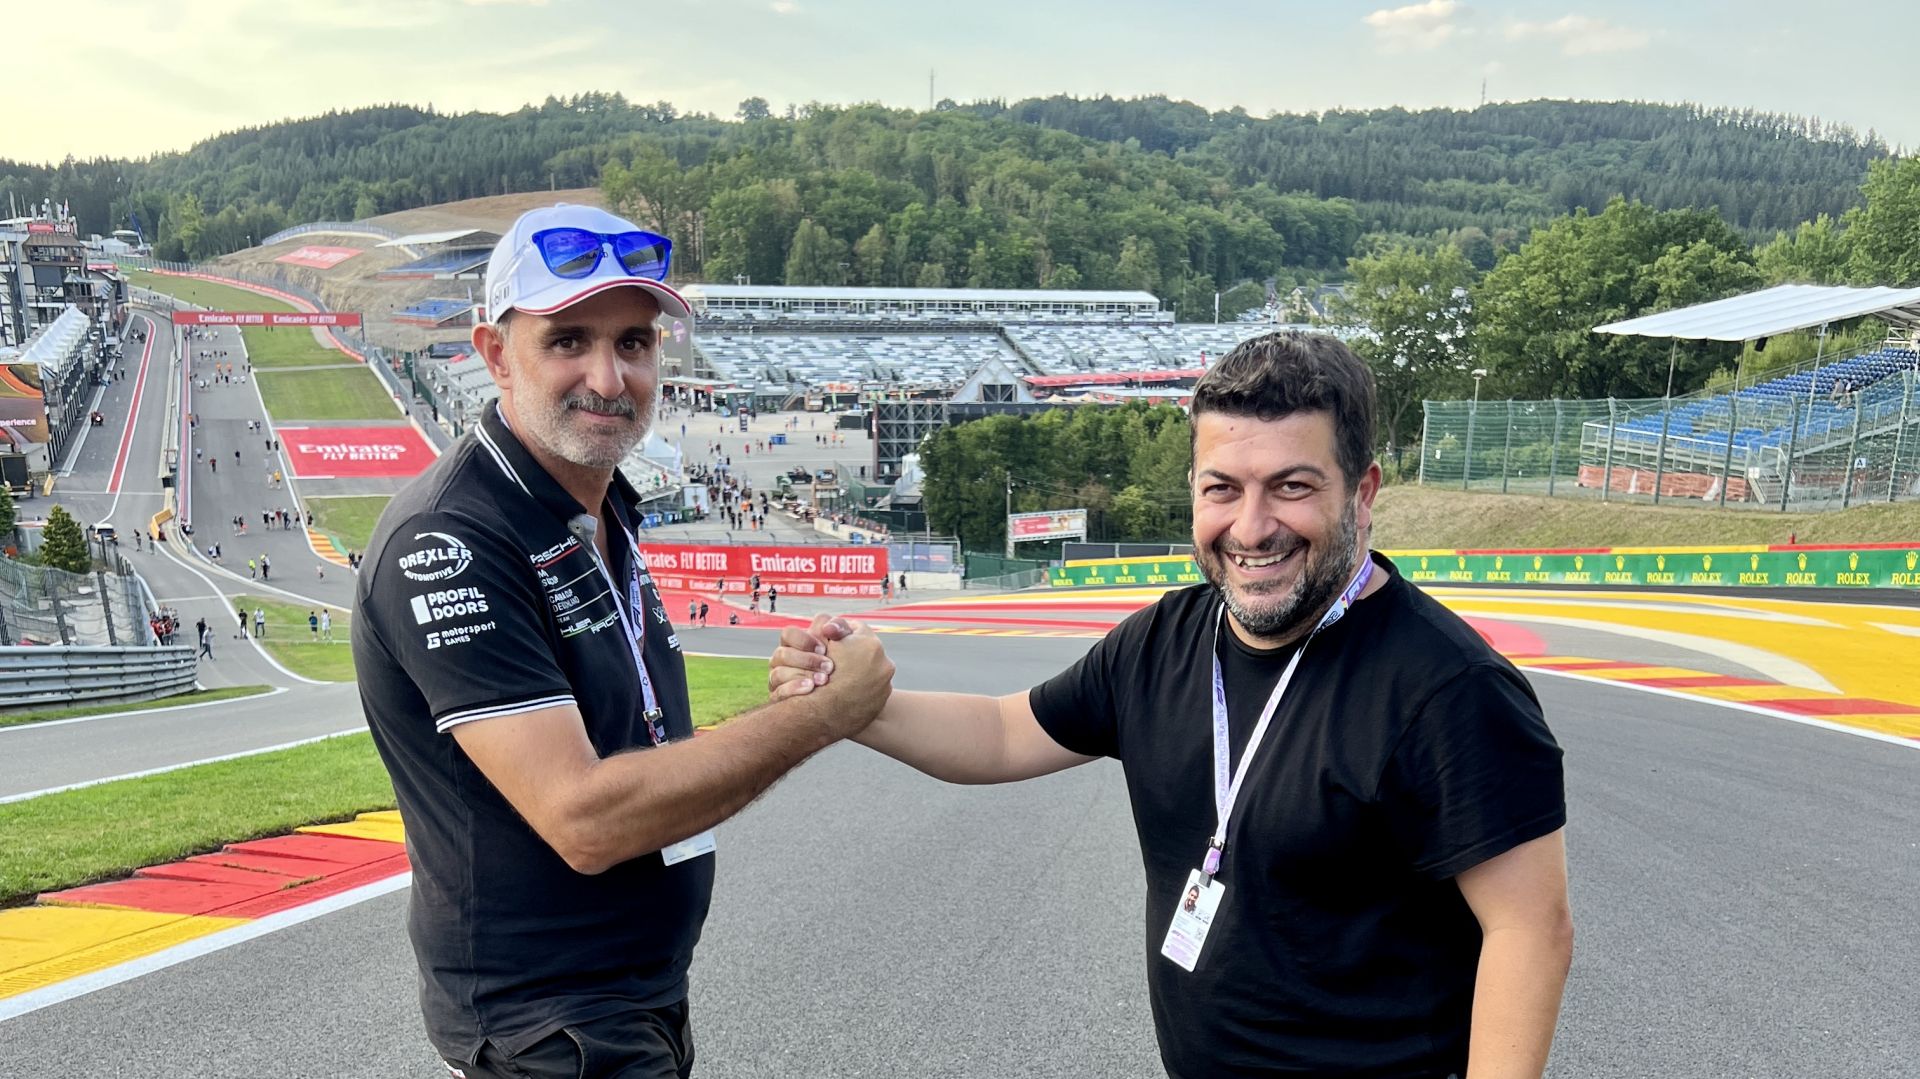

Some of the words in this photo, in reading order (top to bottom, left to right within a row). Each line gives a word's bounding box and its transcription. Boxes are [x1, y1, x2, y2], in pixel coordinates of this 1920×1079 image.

[198, 314, 234, 323] Emirates
[273, 314, 308, 323] Emirates
[298, 443, 407, 454] Emirates
[323, 452, 345, 460] FLY
[350, 452, 399, 460] BETTER
[398, 547, 474, 569] DREXLER
[641, 549, 678, 569] irates
[681, 552, 694, 569] FLY
[695, 553, 728, 571] BETTER
[750, 553, 817, 573] Emirates
[820, 555, 837, 573] FLY
[839, 555, 876, 574] BETTER
[403, 566, 454, 581] AUTOMOTIVE
[1412, 570, 1436, 580] ROLEX
[1449, 571, 1473, 580] ROLEX
[1486, 571, 1511, 581] ROLEX
[1524, 571, 1549, 581] ROLEX
[1565, 571, 1591, 581] ROLEX
[1605, 572, 1632, 583] ROLEX
[1646, 572, 1675, 583] ROLEX
[1691, 572, 1722, 584] ROLEX
[1739, 573, 1769, 584] ROLEX
[1786, 573, 1816, 584] ROLEX
[1836, 573, 1870, 585] ROLEX
[427, 586, 486, 606] PROFIL
[432, 600, 489, 620] DOORS
[441, 620, 496, 639] motorsport
[444, 635, 471, 646] GAMES
